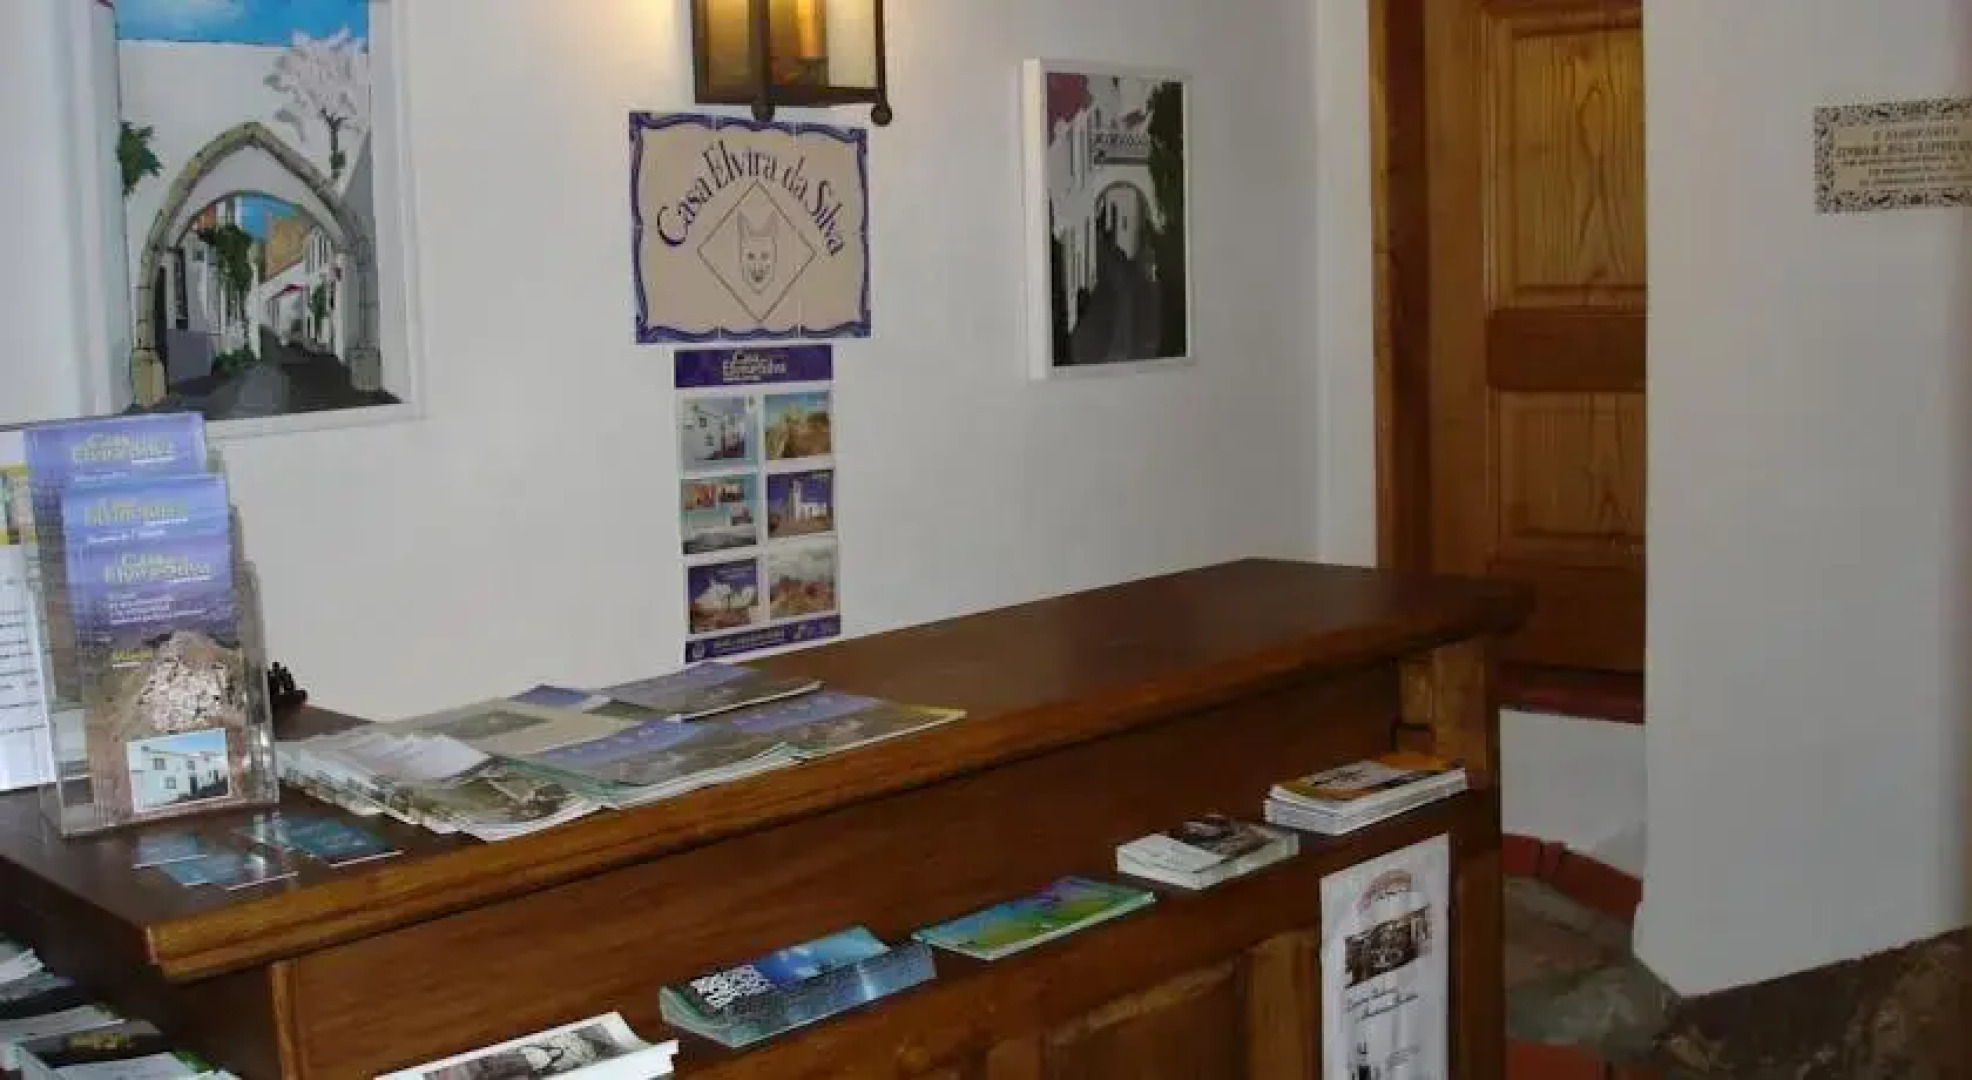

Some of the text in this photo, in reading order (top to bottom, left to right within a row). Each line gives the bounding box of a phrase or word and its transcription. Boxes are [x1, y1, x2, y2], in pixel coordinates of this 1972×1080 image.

[656, 139, 846, 257] Casa Elvira da Silva
